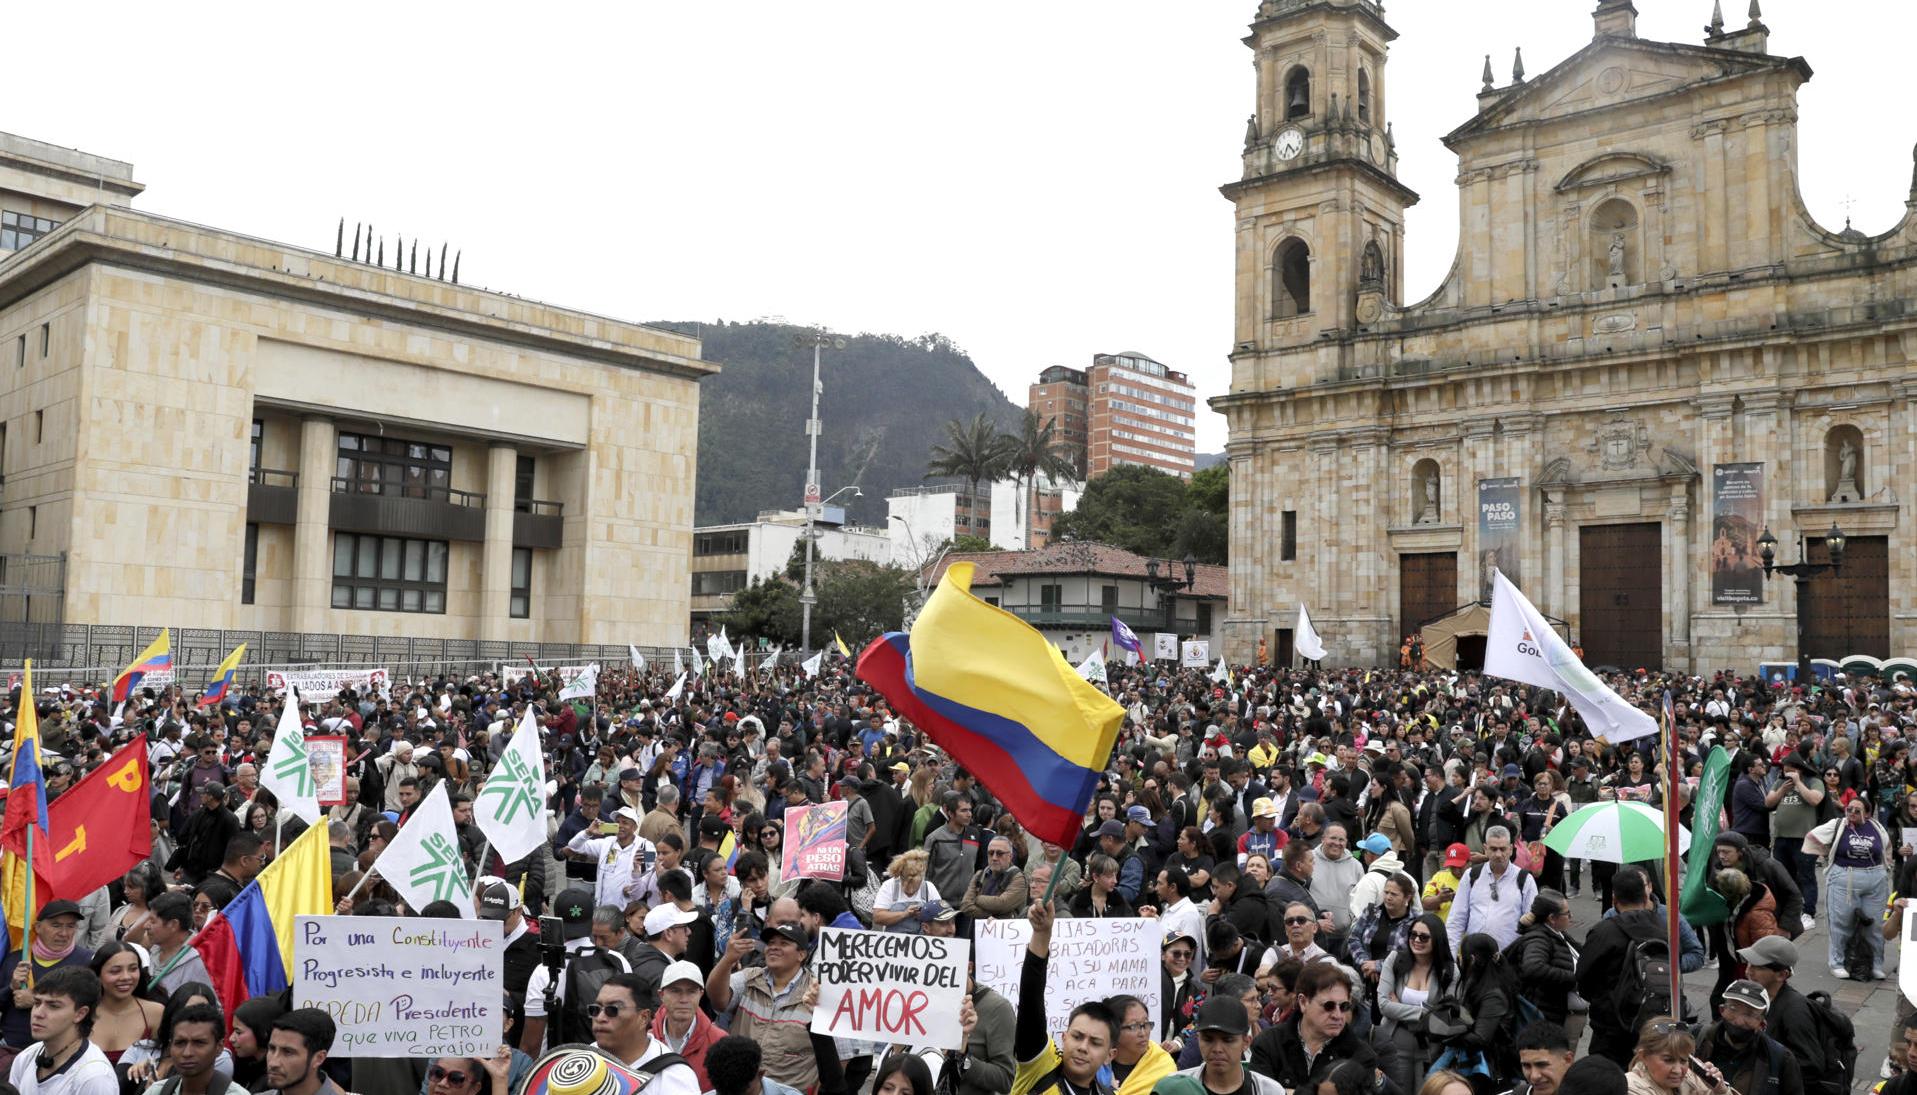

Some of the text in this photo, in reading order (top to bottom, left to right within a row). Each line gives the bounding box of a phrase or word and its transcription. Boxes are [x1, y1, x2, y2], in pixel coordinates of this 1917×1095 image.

[1482, 502, 1510, 512] PASO
[1487, 511, 1515, 521] PASO
[507, 748, 543, 816] SENA
[806, 853, 842, 863] PESO
[304, 921, 328, 946] Por
[347, 933, 376, 947] una
[980, 920, 1146, 940] MIS IJAS SON
[820, 931, 948, 961] MERECEMOS
[1009, 938, 1140, 959] TBAJADORAS
[401, 970, 413, 979] e
[817, 960, 961, 989] PODER VIVIR DEL
[981, 964, 1006, 982] SU
[1112, 975, 1149, 990] PARA
[828, 987, 930, 1036] AMOR
[342, 1032, 377, 1052] que
[429, 1024, 484, 1041] PETRO
